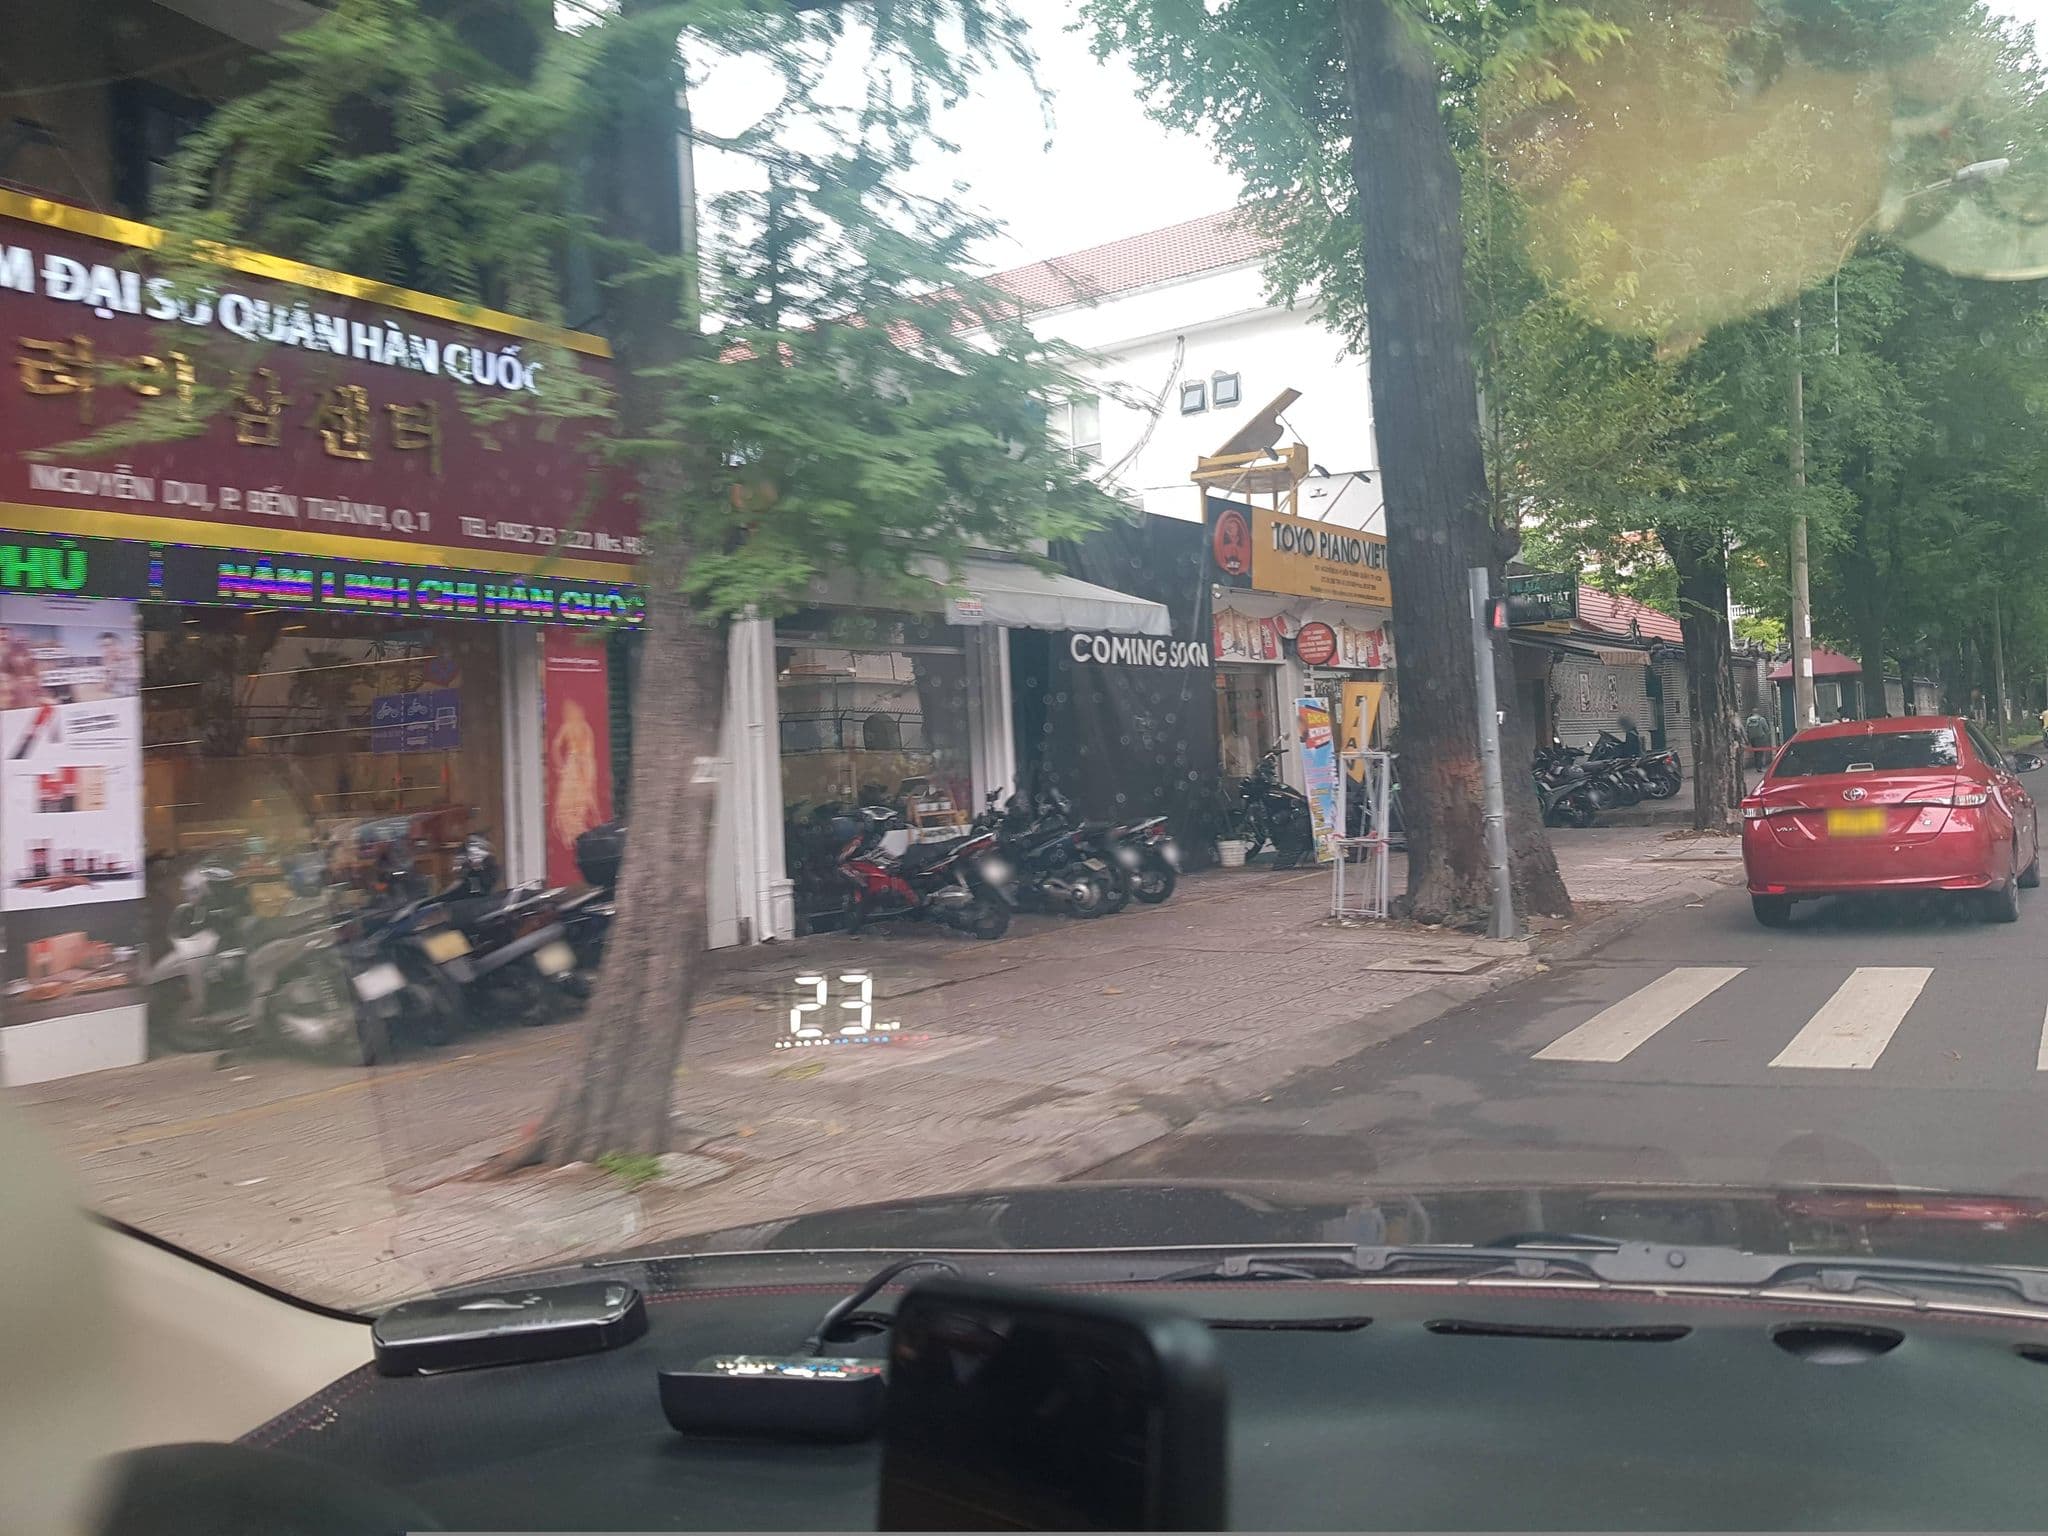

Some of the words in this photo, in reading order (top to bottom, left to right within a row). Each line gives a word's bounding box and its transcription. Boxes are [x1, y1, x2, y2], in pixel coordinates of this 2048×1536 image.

[40, 254, 141, 320] ĐẠI
[351, 319, 440, 374] HÀN
[1271, 521, 1315, 556] TOYO
[1317, 531, 1362, 566] PIANO
[416, 579, 478, 612] CHI
[1070, 633, 1168, 668] COMING
[790, 974, 873, 1037] 23
